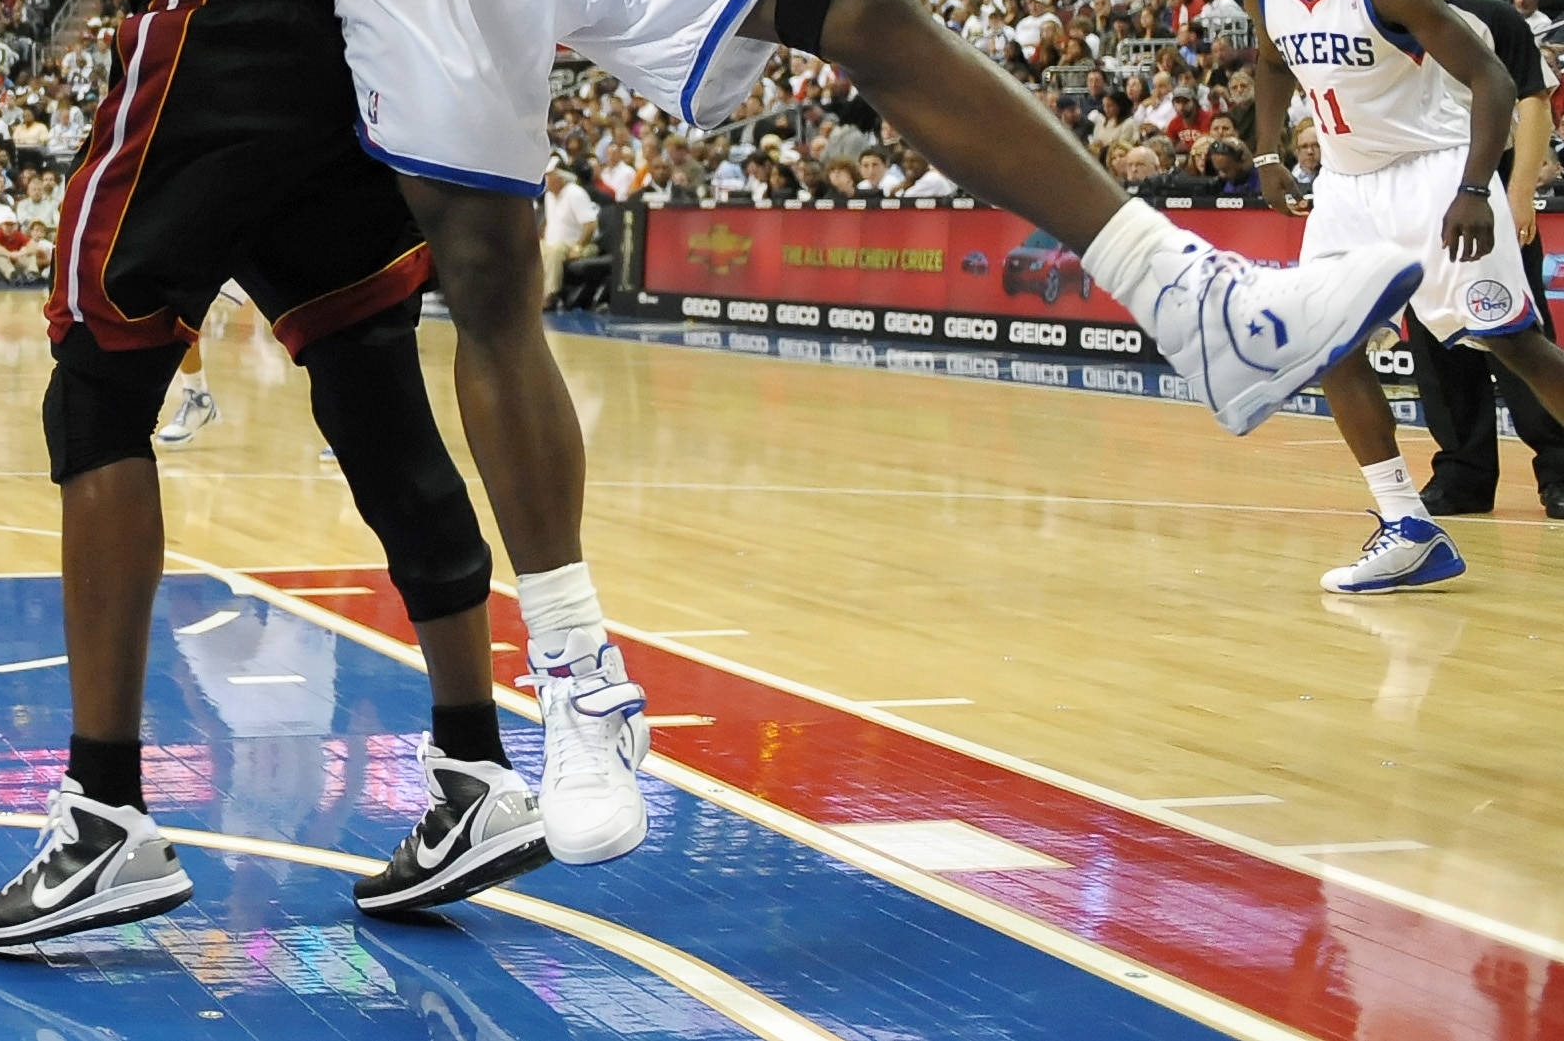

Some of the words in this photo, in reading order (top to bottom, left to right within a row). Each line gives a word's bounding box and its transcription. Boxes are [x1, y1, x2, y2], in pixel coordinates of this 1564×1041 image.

[1308, 87, 1353, 136] 11
[858, 246, 899, 271] CHEVY
[900, 247, 944, 273] CRUZE
[681, 296, 721, 318] GEICO
[726, 300, 769, 323] GEICO
[775, 303, 820, 327] GEICO
[1471, 296, 1507, 314] 76ers
[827, 307, 876, 332] GEICO
[884, 311, 934, 336] GEICO
[943, 315, 998, 341] GEICO
[1008, 320, 1067, 347] GEICO
[1080, 326, 1142, 354] GEICO
[1368, 349, 1415, 376] ICO
